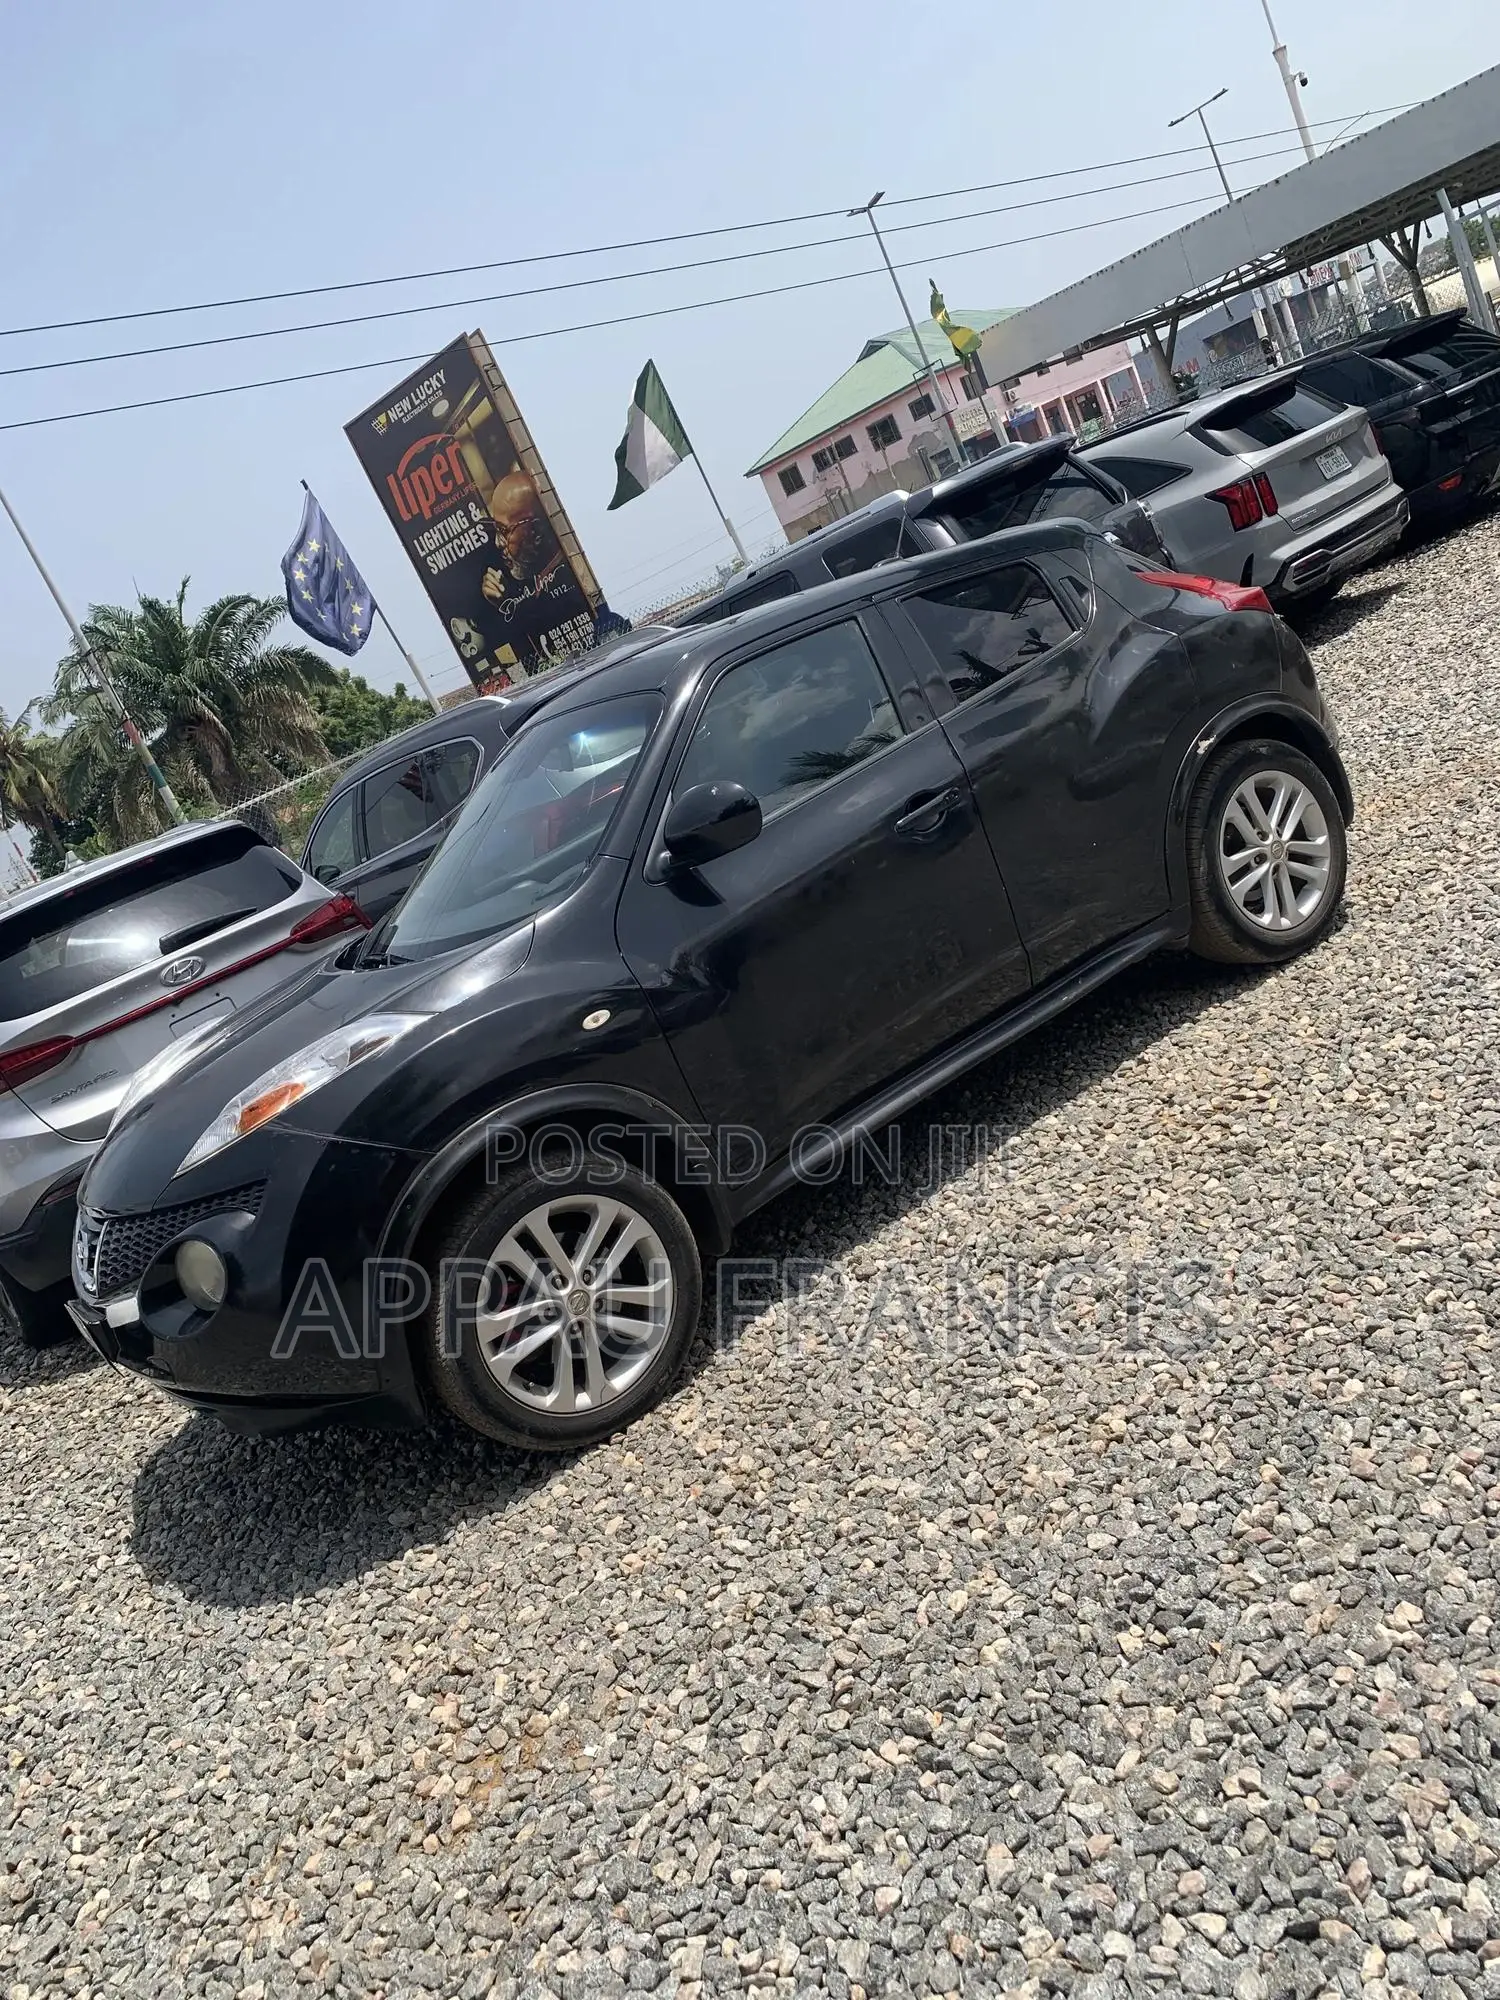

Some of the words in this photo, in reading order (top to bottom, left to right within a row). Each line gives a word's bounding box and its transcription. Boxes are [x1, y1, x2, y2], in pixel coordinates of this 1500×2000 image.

[387, 394, 412, 423] NEW
[410, 369, 447, 406] LUCKY
[402, 401, 429, 424] ELECTRICALS
[413, 509, 469, 557] LIGHTING
[468, 501, 484, 521] &
[426, 524, 489, 576] SWITCHES
[548, 626, 563, 641] 024
[560, 620, 574, 635] 297
[573, 611, 591, 628] 1338
[553, 635, 567, 649] 054
